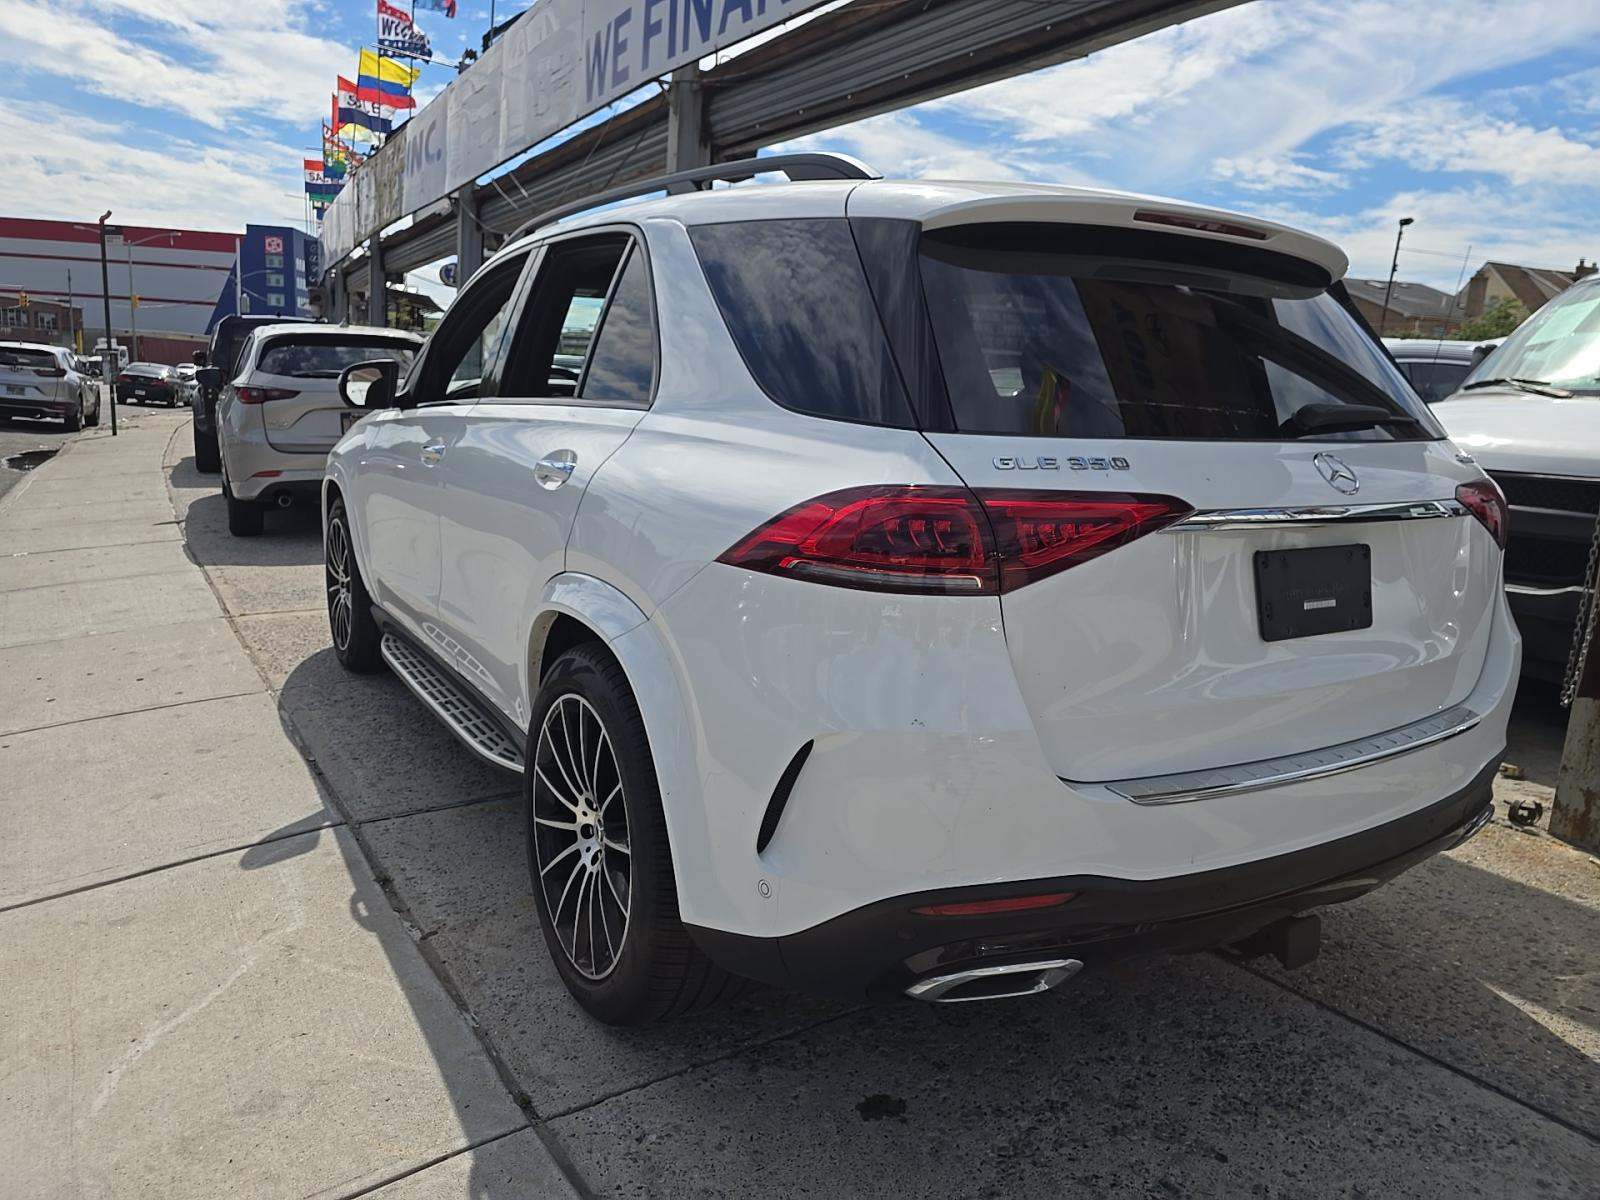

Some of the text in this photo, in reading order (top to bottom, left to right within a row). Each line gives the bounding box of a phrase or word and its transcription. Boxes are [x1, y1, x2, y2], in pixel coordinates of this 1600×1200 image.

[584, 7, 632, 103] WE
[993, 456, 1130, 471] GLE 350
